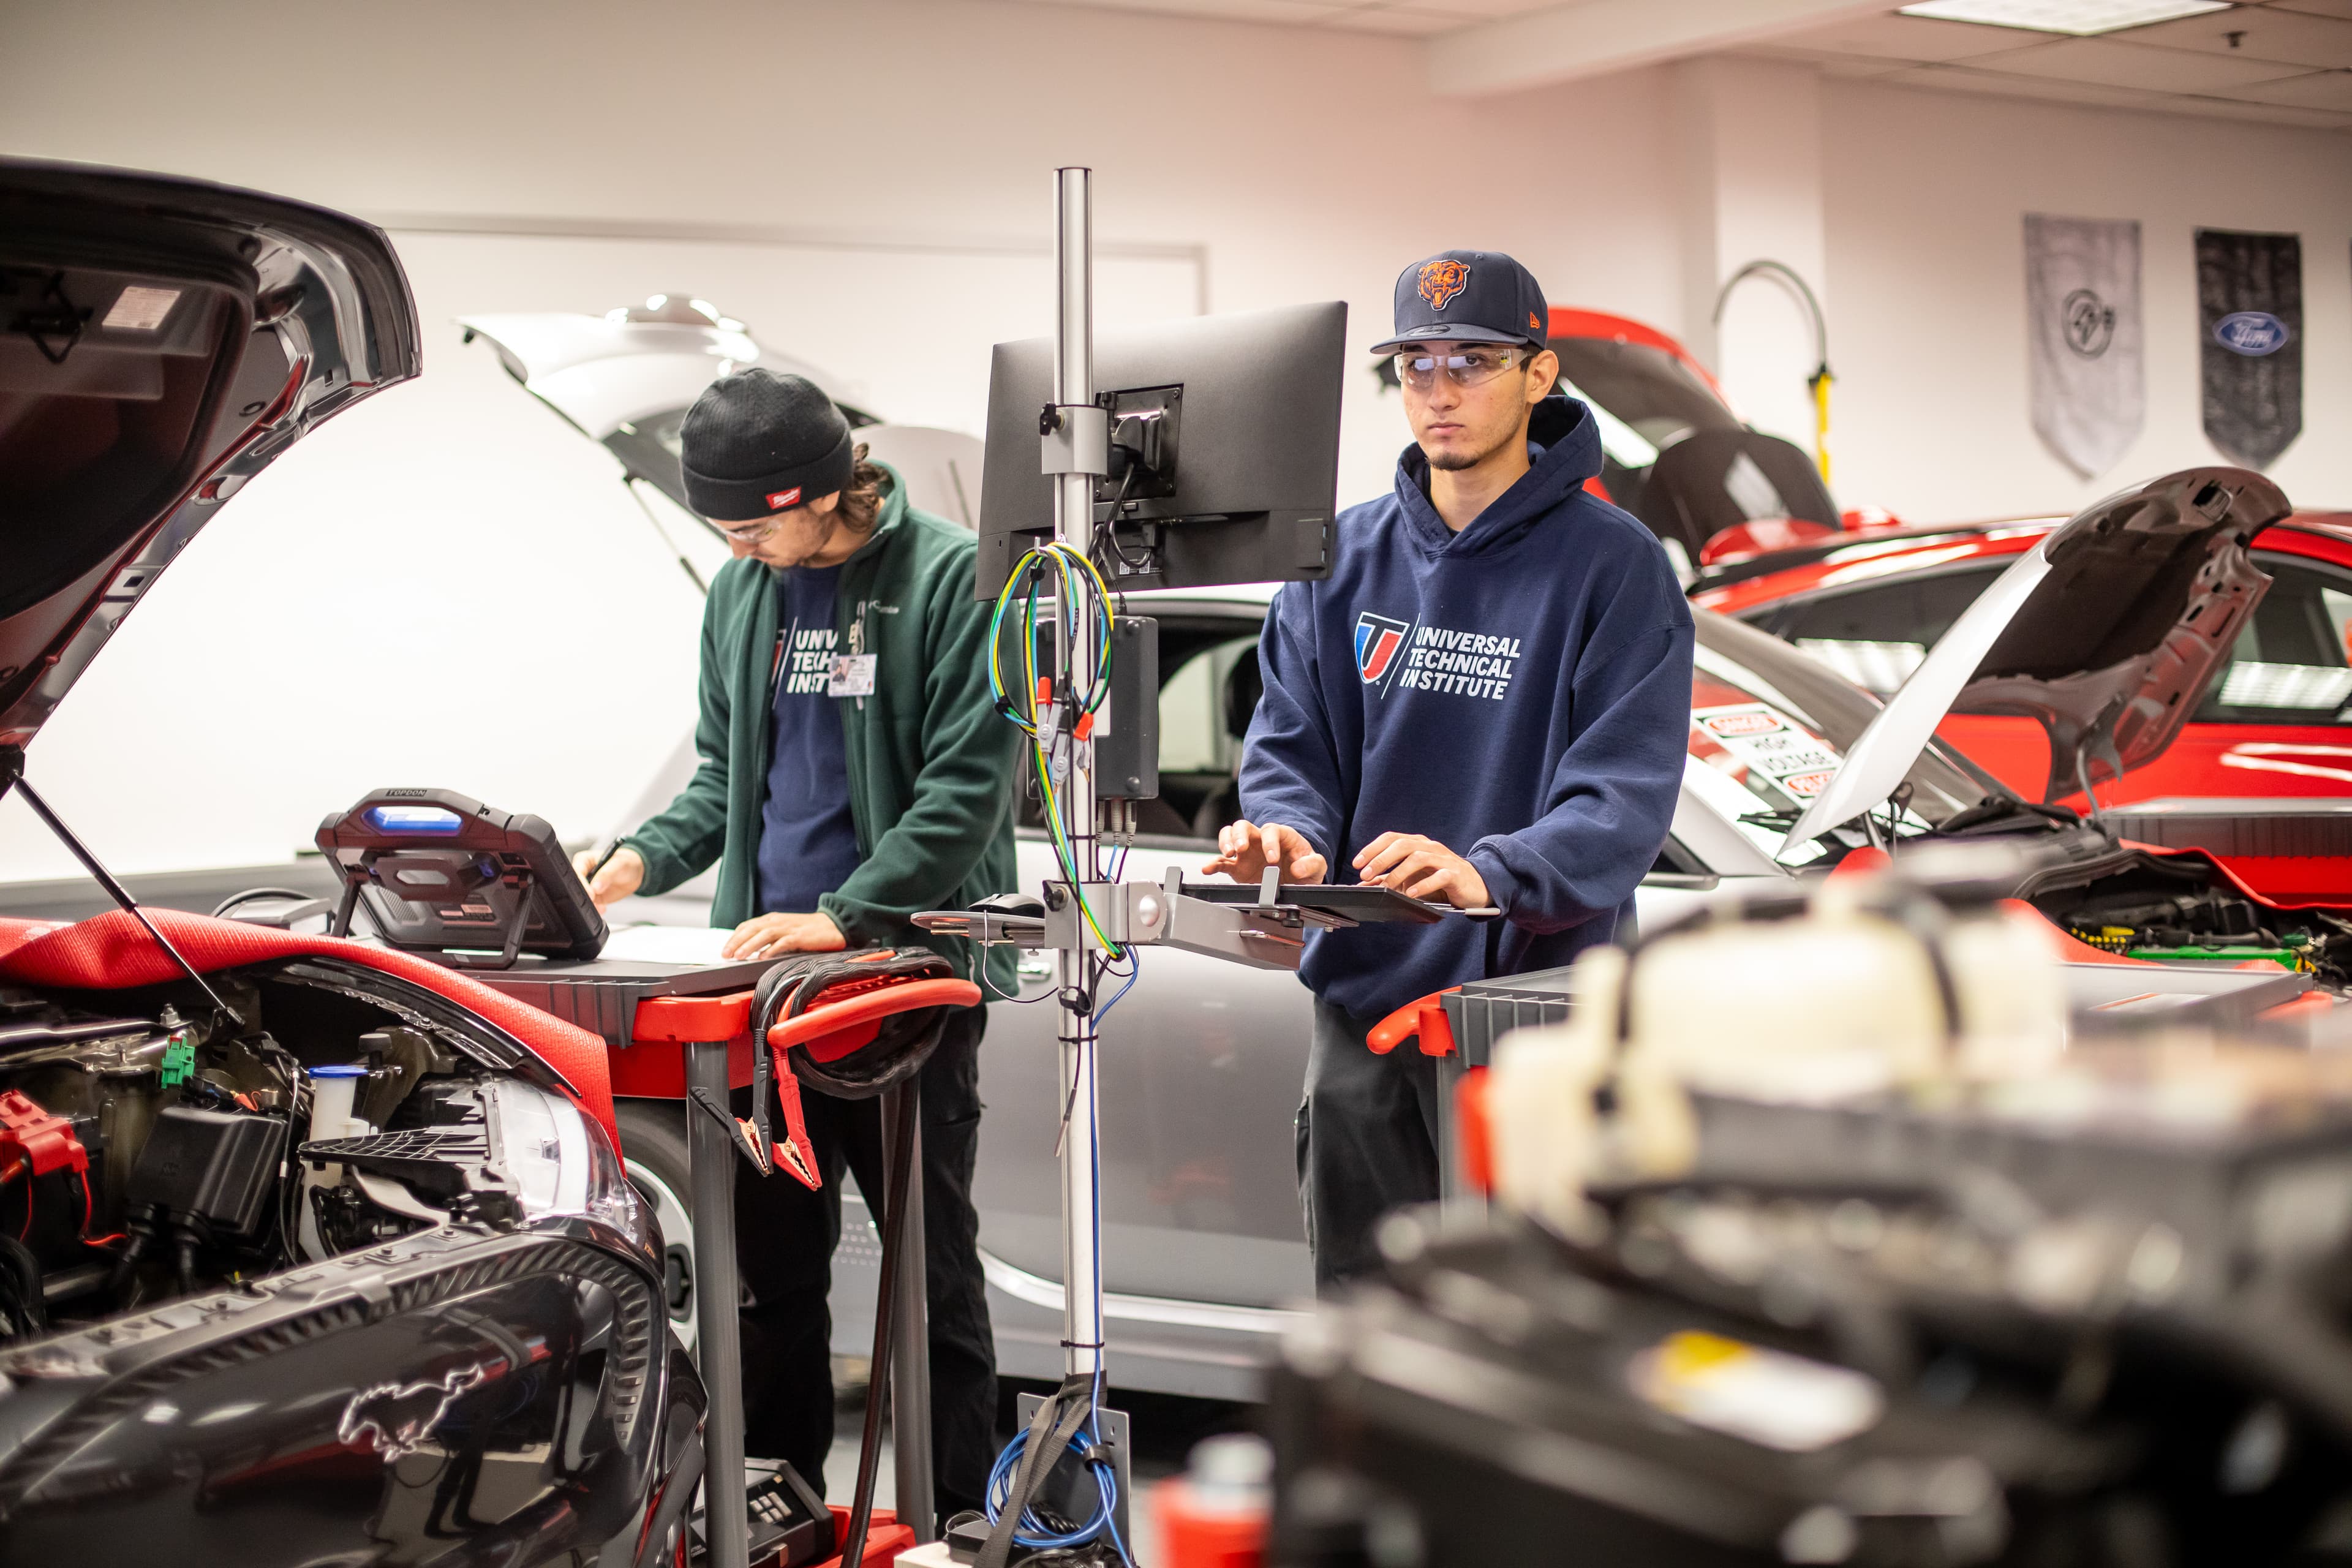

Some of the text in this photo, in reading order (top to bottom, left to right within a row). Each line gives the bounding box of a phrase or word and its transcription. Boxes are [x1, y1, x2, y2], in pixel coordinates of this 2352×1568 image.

[1415, 627, 1521, 658] UNIVERSAL
[1408, 648, 1512, 679] TECHNICAL
[1399, 668, 1508, 700] INSTITUTE
